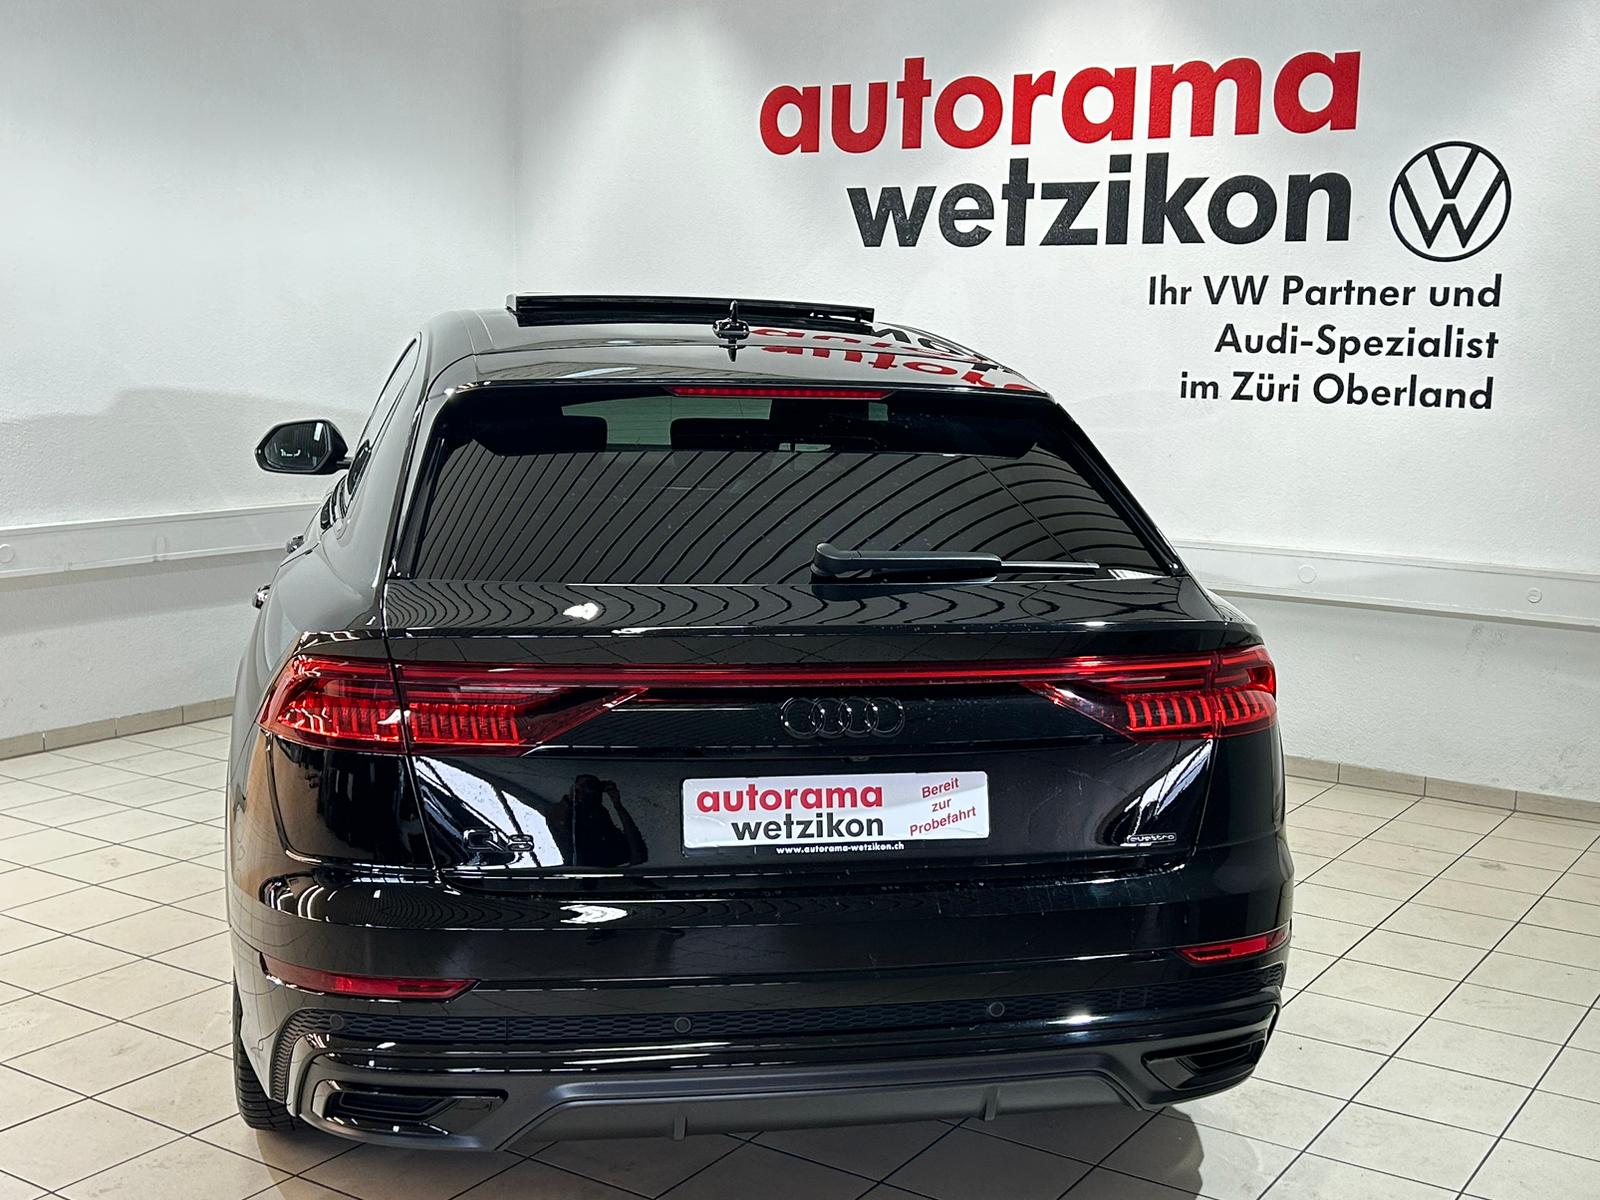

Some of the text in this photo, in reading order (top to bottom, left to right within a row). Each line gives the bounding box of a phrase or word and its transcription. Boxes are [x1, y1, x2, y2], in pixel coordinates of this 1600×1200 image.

[760, 52, 1360, 154] autorama
[847, 153, 1351, 247] wetzikon
[1149, 274, 1502, 308] Ihr VW Partner und
[1215, 323, 1499, 363] Audi-Spezialist
[1181, 371, 1494, 409] im Züri Oberland
[697, 784, 883, 812] autorama
[922, 777, 959, 799] Bereit
[932, 798, 952, 812] zur
[731, 812, 884, 840] wetzikon
[910, 806, 976, 836] Probefahrt
[776, 842, 905, 854] www.autorama-wetzikon.ch
